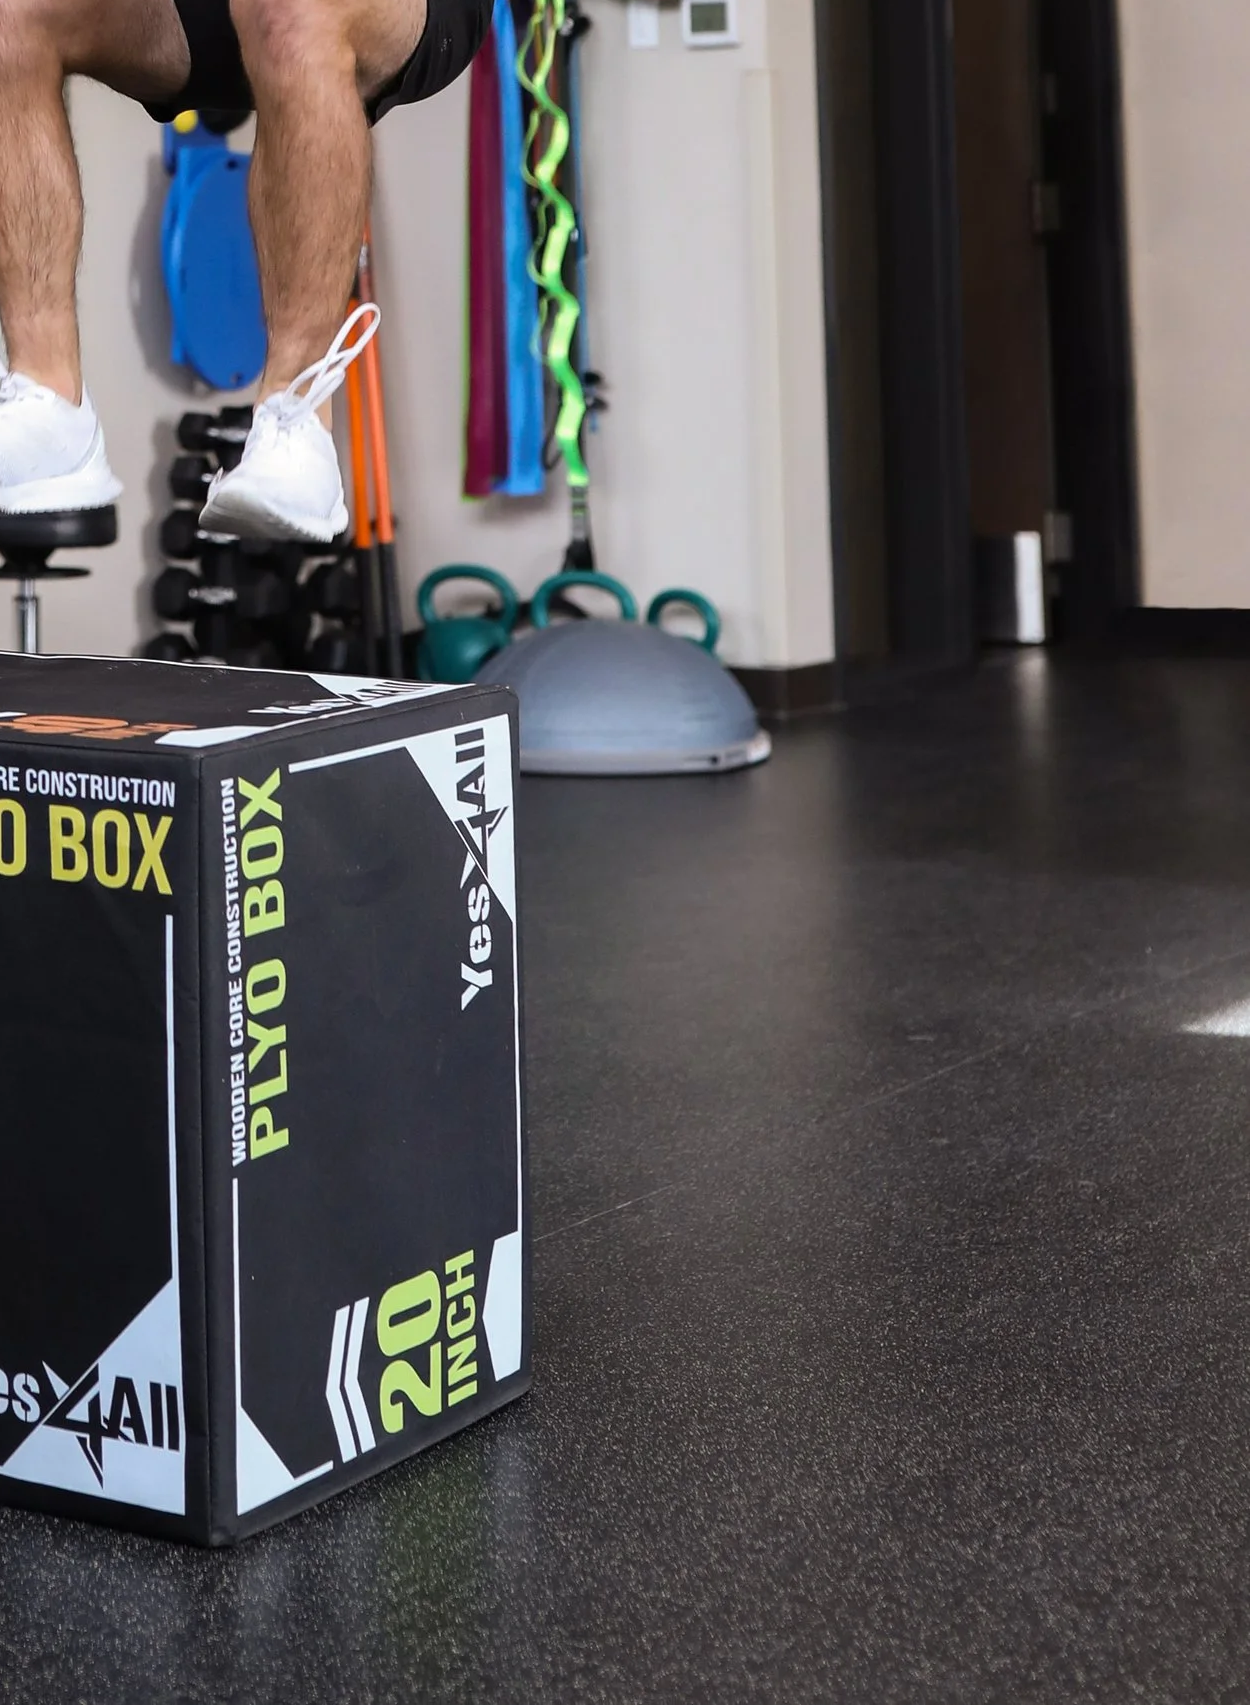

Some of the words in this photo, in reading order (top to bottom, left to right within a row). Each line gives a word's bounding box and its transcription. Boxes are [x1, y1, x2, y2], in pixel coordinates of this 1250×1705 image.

[25, 768, 176, 808] CONSTRUCTION
[48, 803, 174, 896] BOX
[237, 767, 286, 938] BOX
[220, 777, 242, 974] CONSTRUCTION
[228, 977, 244, 1049] CORE
[246, 957, 290, 1161] PLYO
[231, 1054, 247, 1168] WOODEN
[377, 1269, 442, 1434] 20
[445, 1249, 478, 1408] INCH
